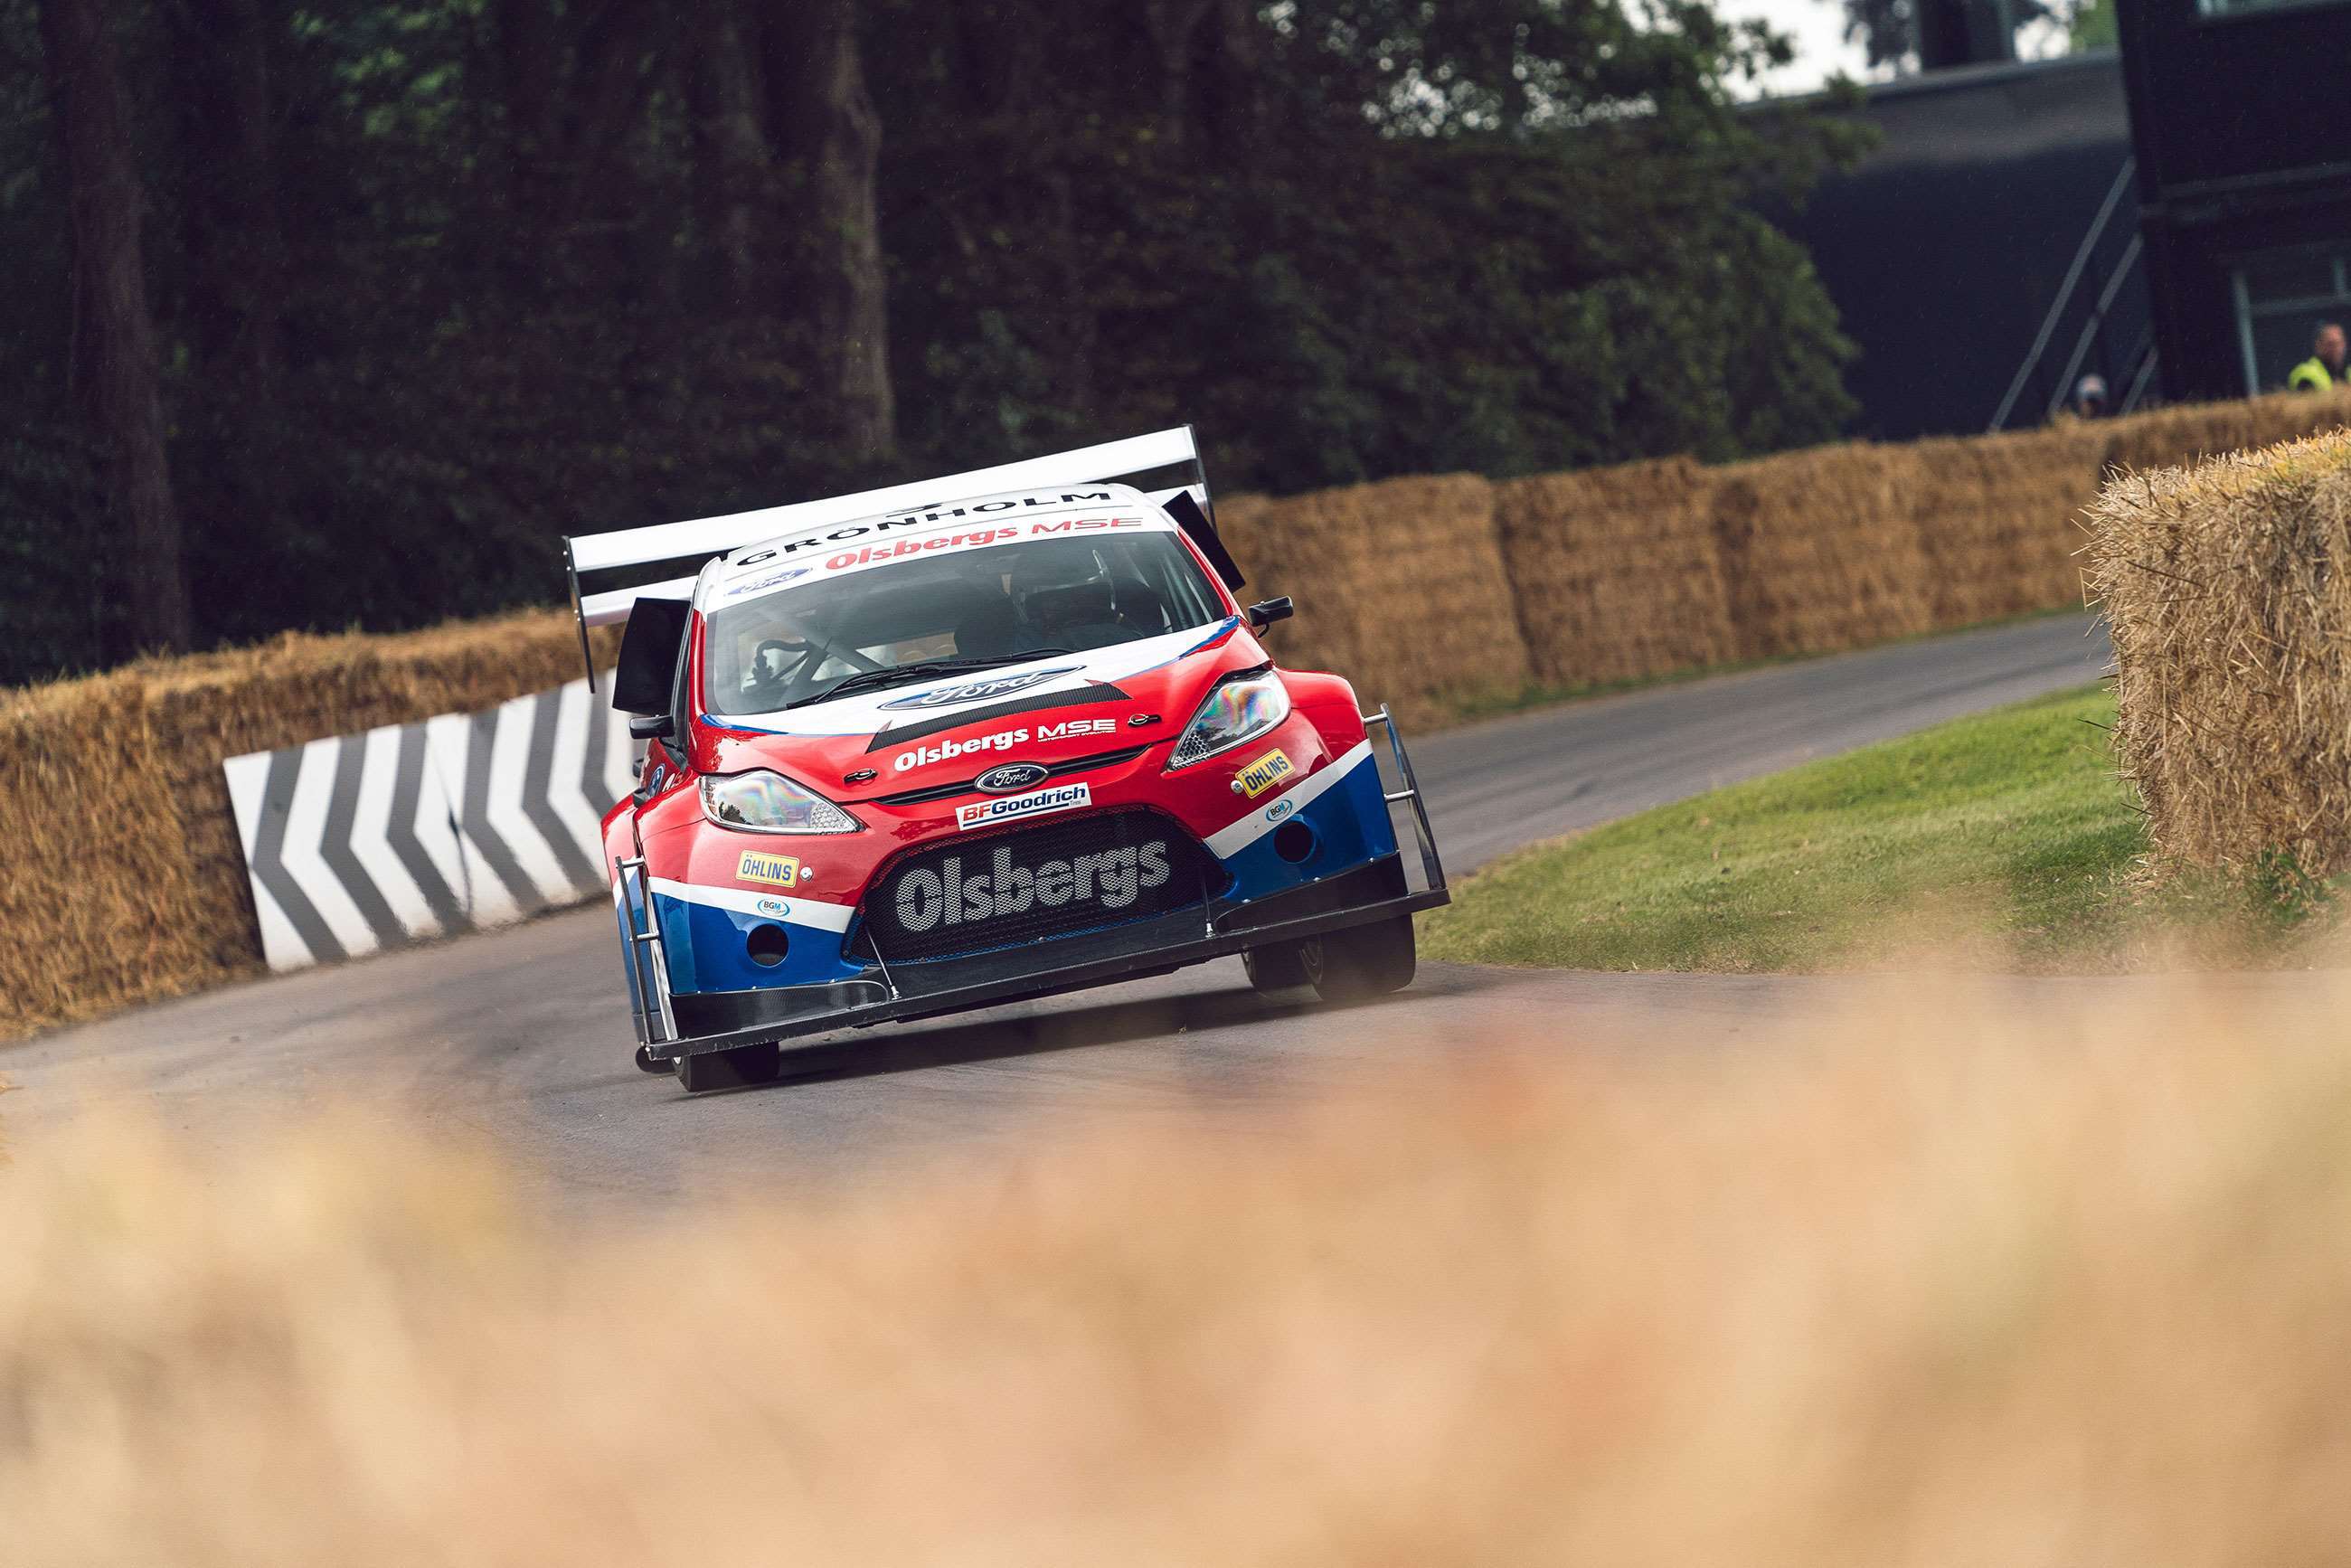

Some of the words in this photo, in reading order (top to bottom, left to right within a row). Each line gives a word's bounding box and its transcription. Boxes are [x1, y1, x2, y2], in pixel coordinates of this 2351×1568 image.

[737, 492, 1111, 566] GRÖNHOLM
[826, 526, 1018, 570] Olsbergs
[1032, 517, 1143, 534] MSE
[921, 671, 1043, 705] Ford
[893, 727, 1030, 772] Olsbergs
[1037, 719, 1116, 739] MSE
[993, 769, 1031, 787] Ford
[1242, 755, 1289, 791] ÖHLINS
[962, 787, 1086, 822] BFGoodrich
[741, 854, 792, 882] ÖHLINS
[896, 840, 1171, 932] Olsbergs
[763, 901, 781, 911] BGM
